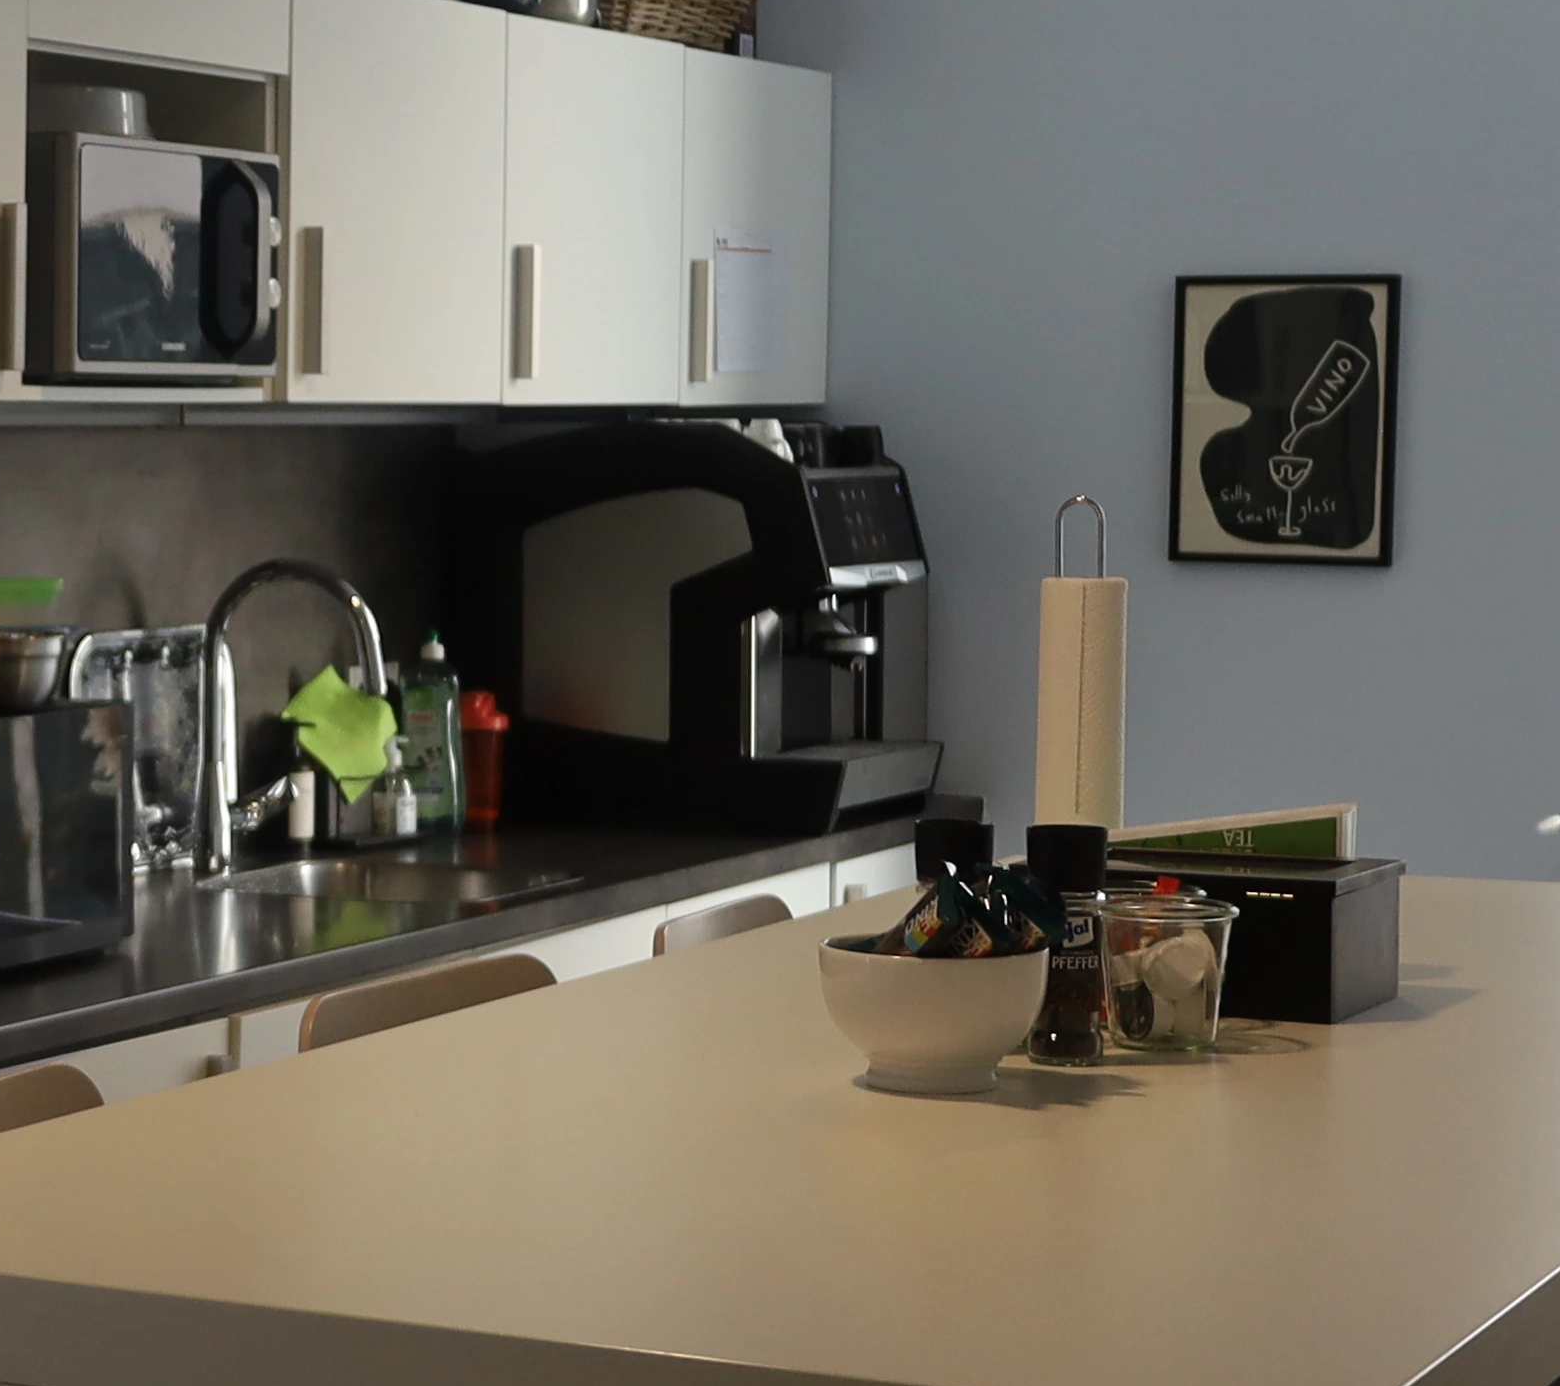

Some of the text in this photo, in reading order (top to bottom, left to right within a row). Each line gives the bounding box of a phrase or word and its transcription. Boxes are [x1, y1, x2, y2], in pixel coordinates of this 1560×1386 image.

[1306, 356, 1353, 414] VINO
[1222, 828, 1254, 848] TEA
[1068, 916, 1090, 942] ja!
[1051, 955, 1100, 970] PFEFFER
